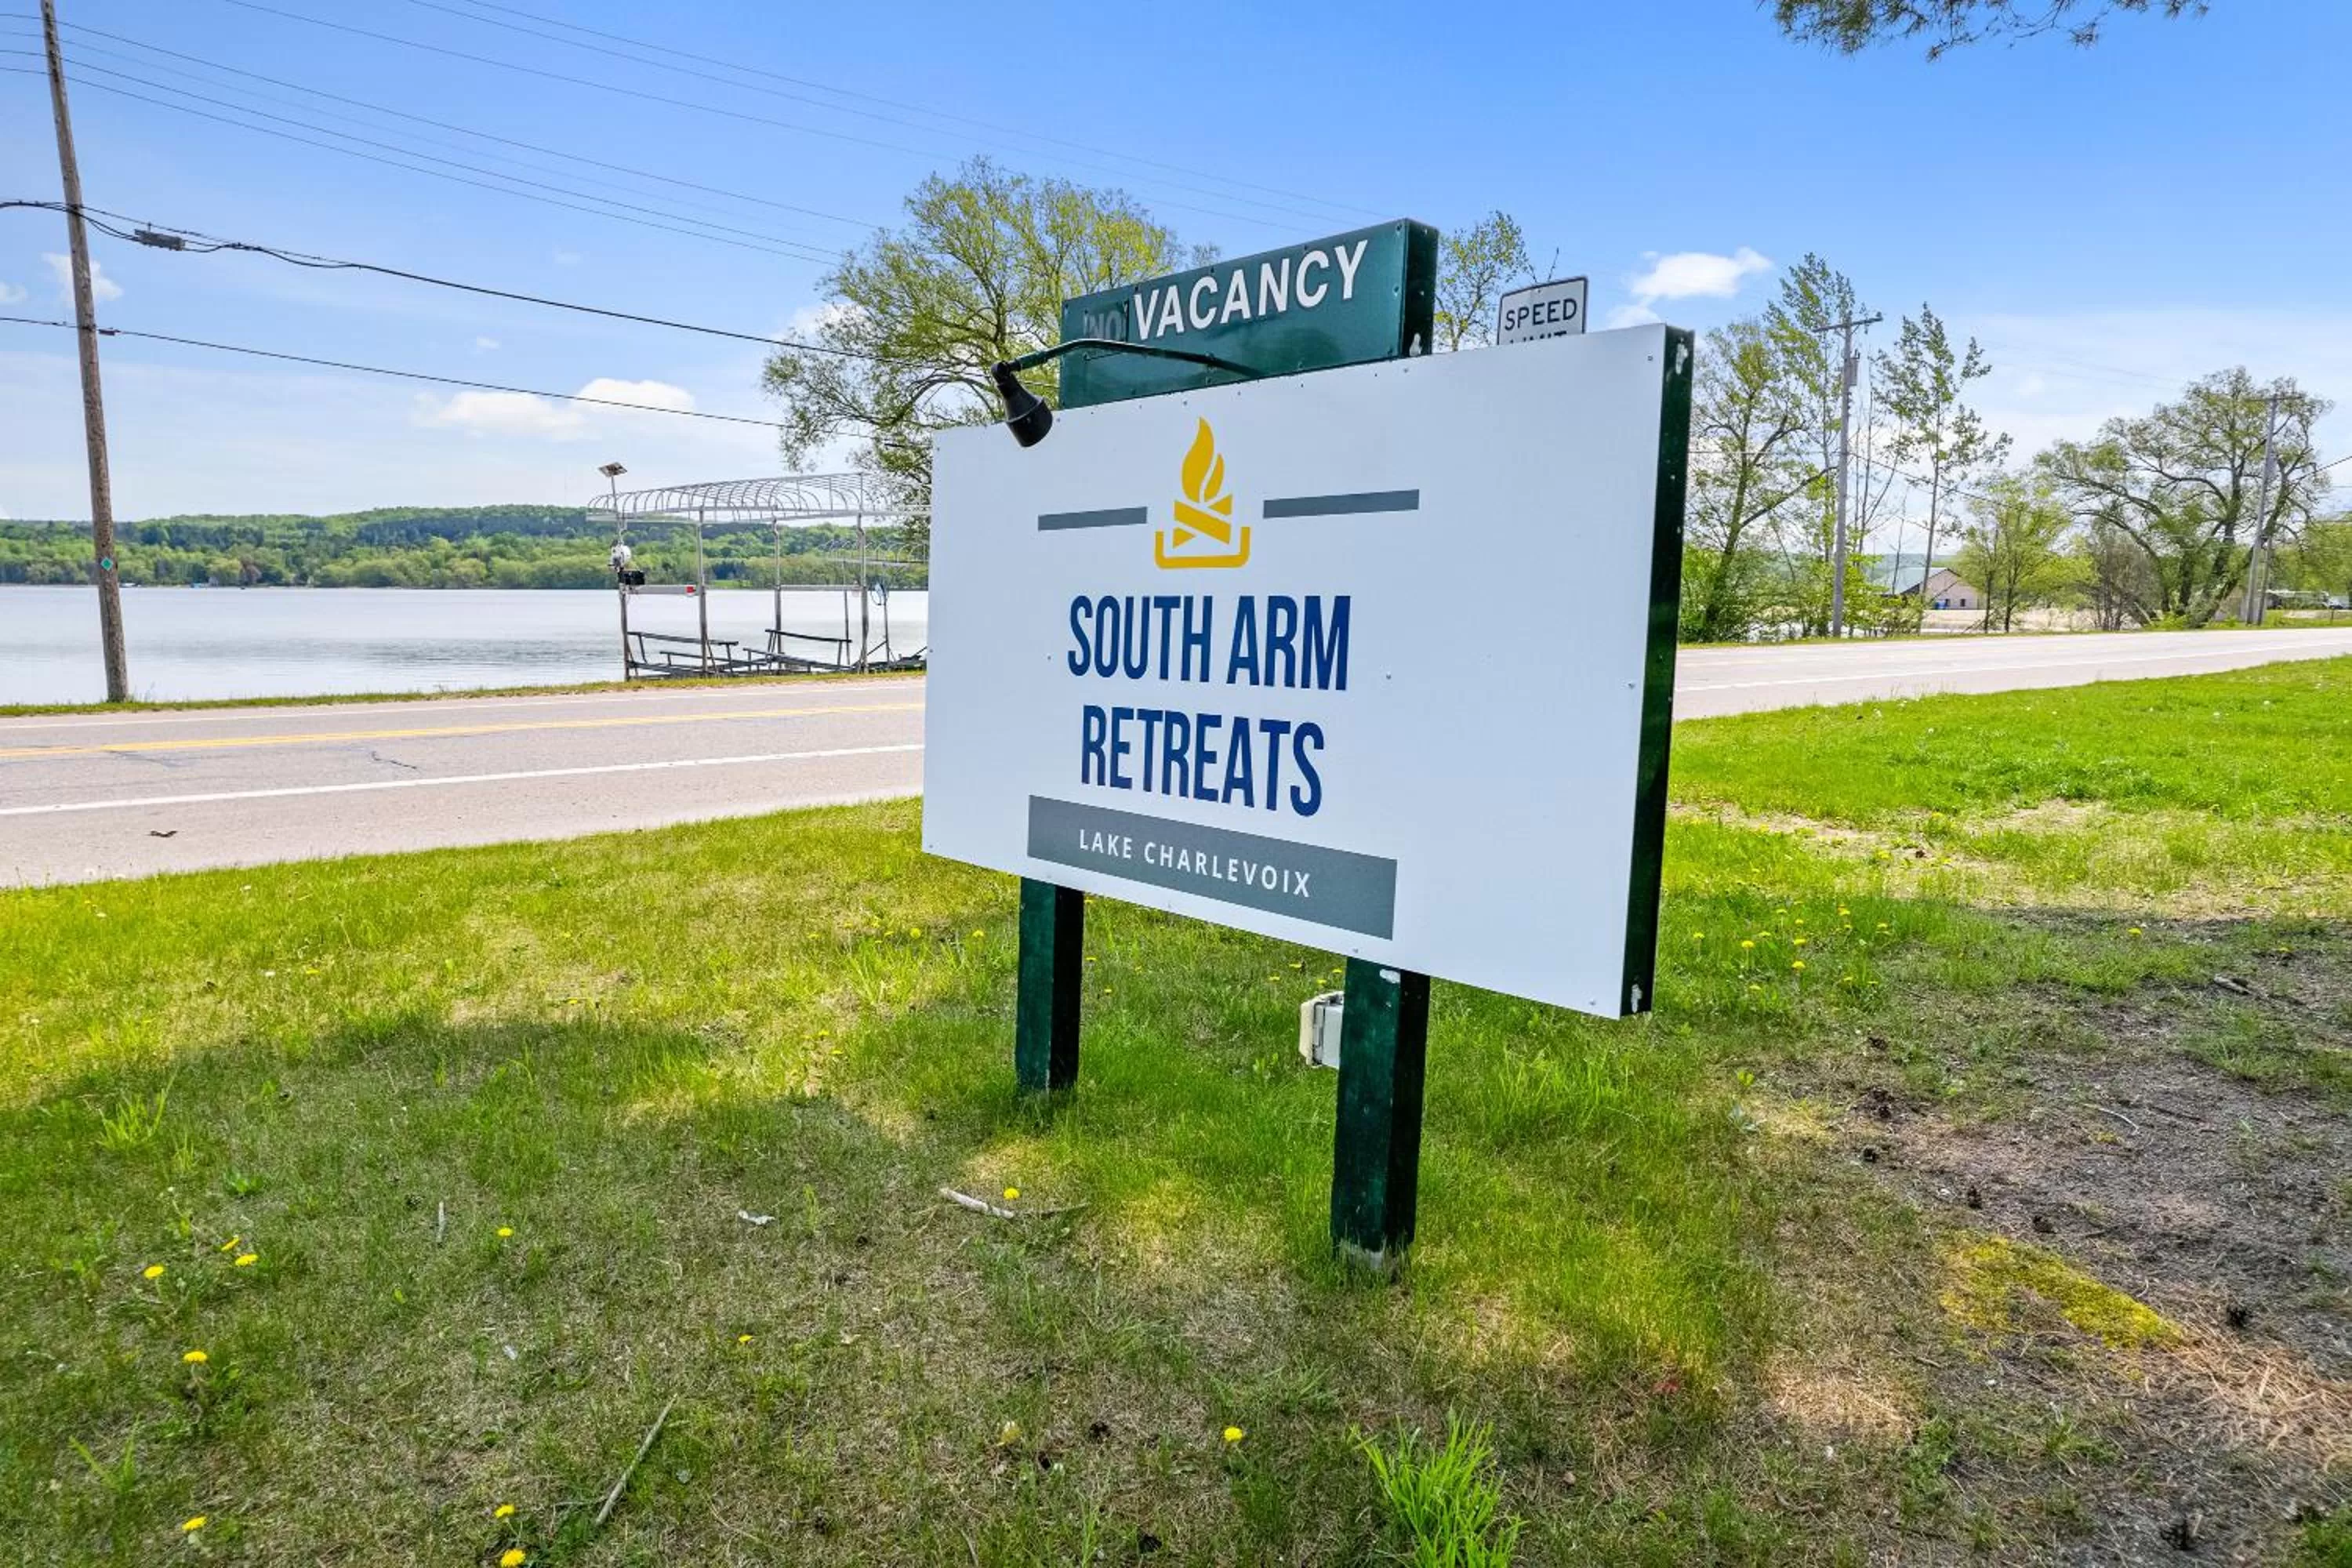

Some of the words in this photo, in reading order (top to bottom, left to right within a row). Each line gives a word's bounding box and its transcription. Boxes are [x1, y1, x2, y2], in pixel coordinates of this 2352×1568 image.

[1134, 240, 1368, 340] VACANCY
[1504, 298, 1577, 331] SPEED
[1068, 595, 1213, 683] SOUTH
[1226, 595, 1352, 691] ARM
[1081, 704, 1325, 818] RETREATS
[1079, 829, 1133, 859] LAKE
[1144, 841, 1310, 898] CHARLEVOIX
